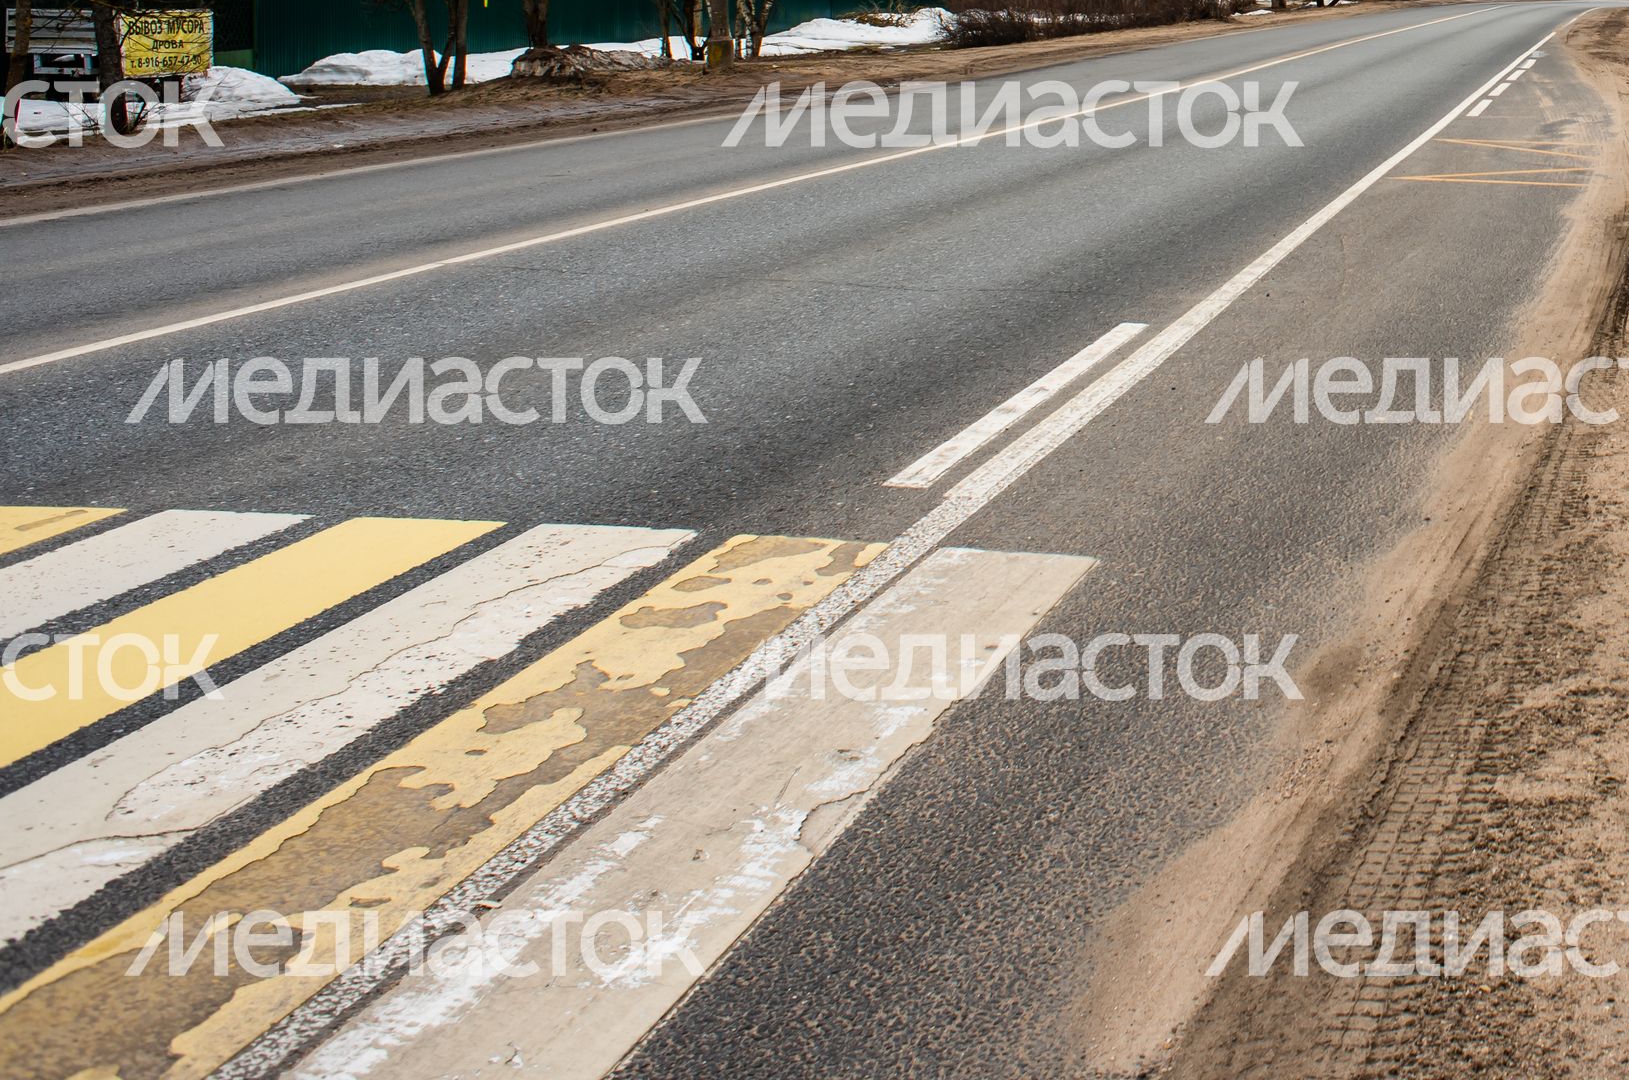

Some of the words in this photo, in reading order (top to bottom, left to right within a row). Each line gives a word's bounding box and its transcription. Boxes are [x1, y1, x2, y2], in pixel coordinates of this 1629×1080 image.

[128, 19, 163, 35] ВЫВОЗ
[167, 18, 205, 34] МУСОРА
[152, 39, 185, 50] ДРОВА
